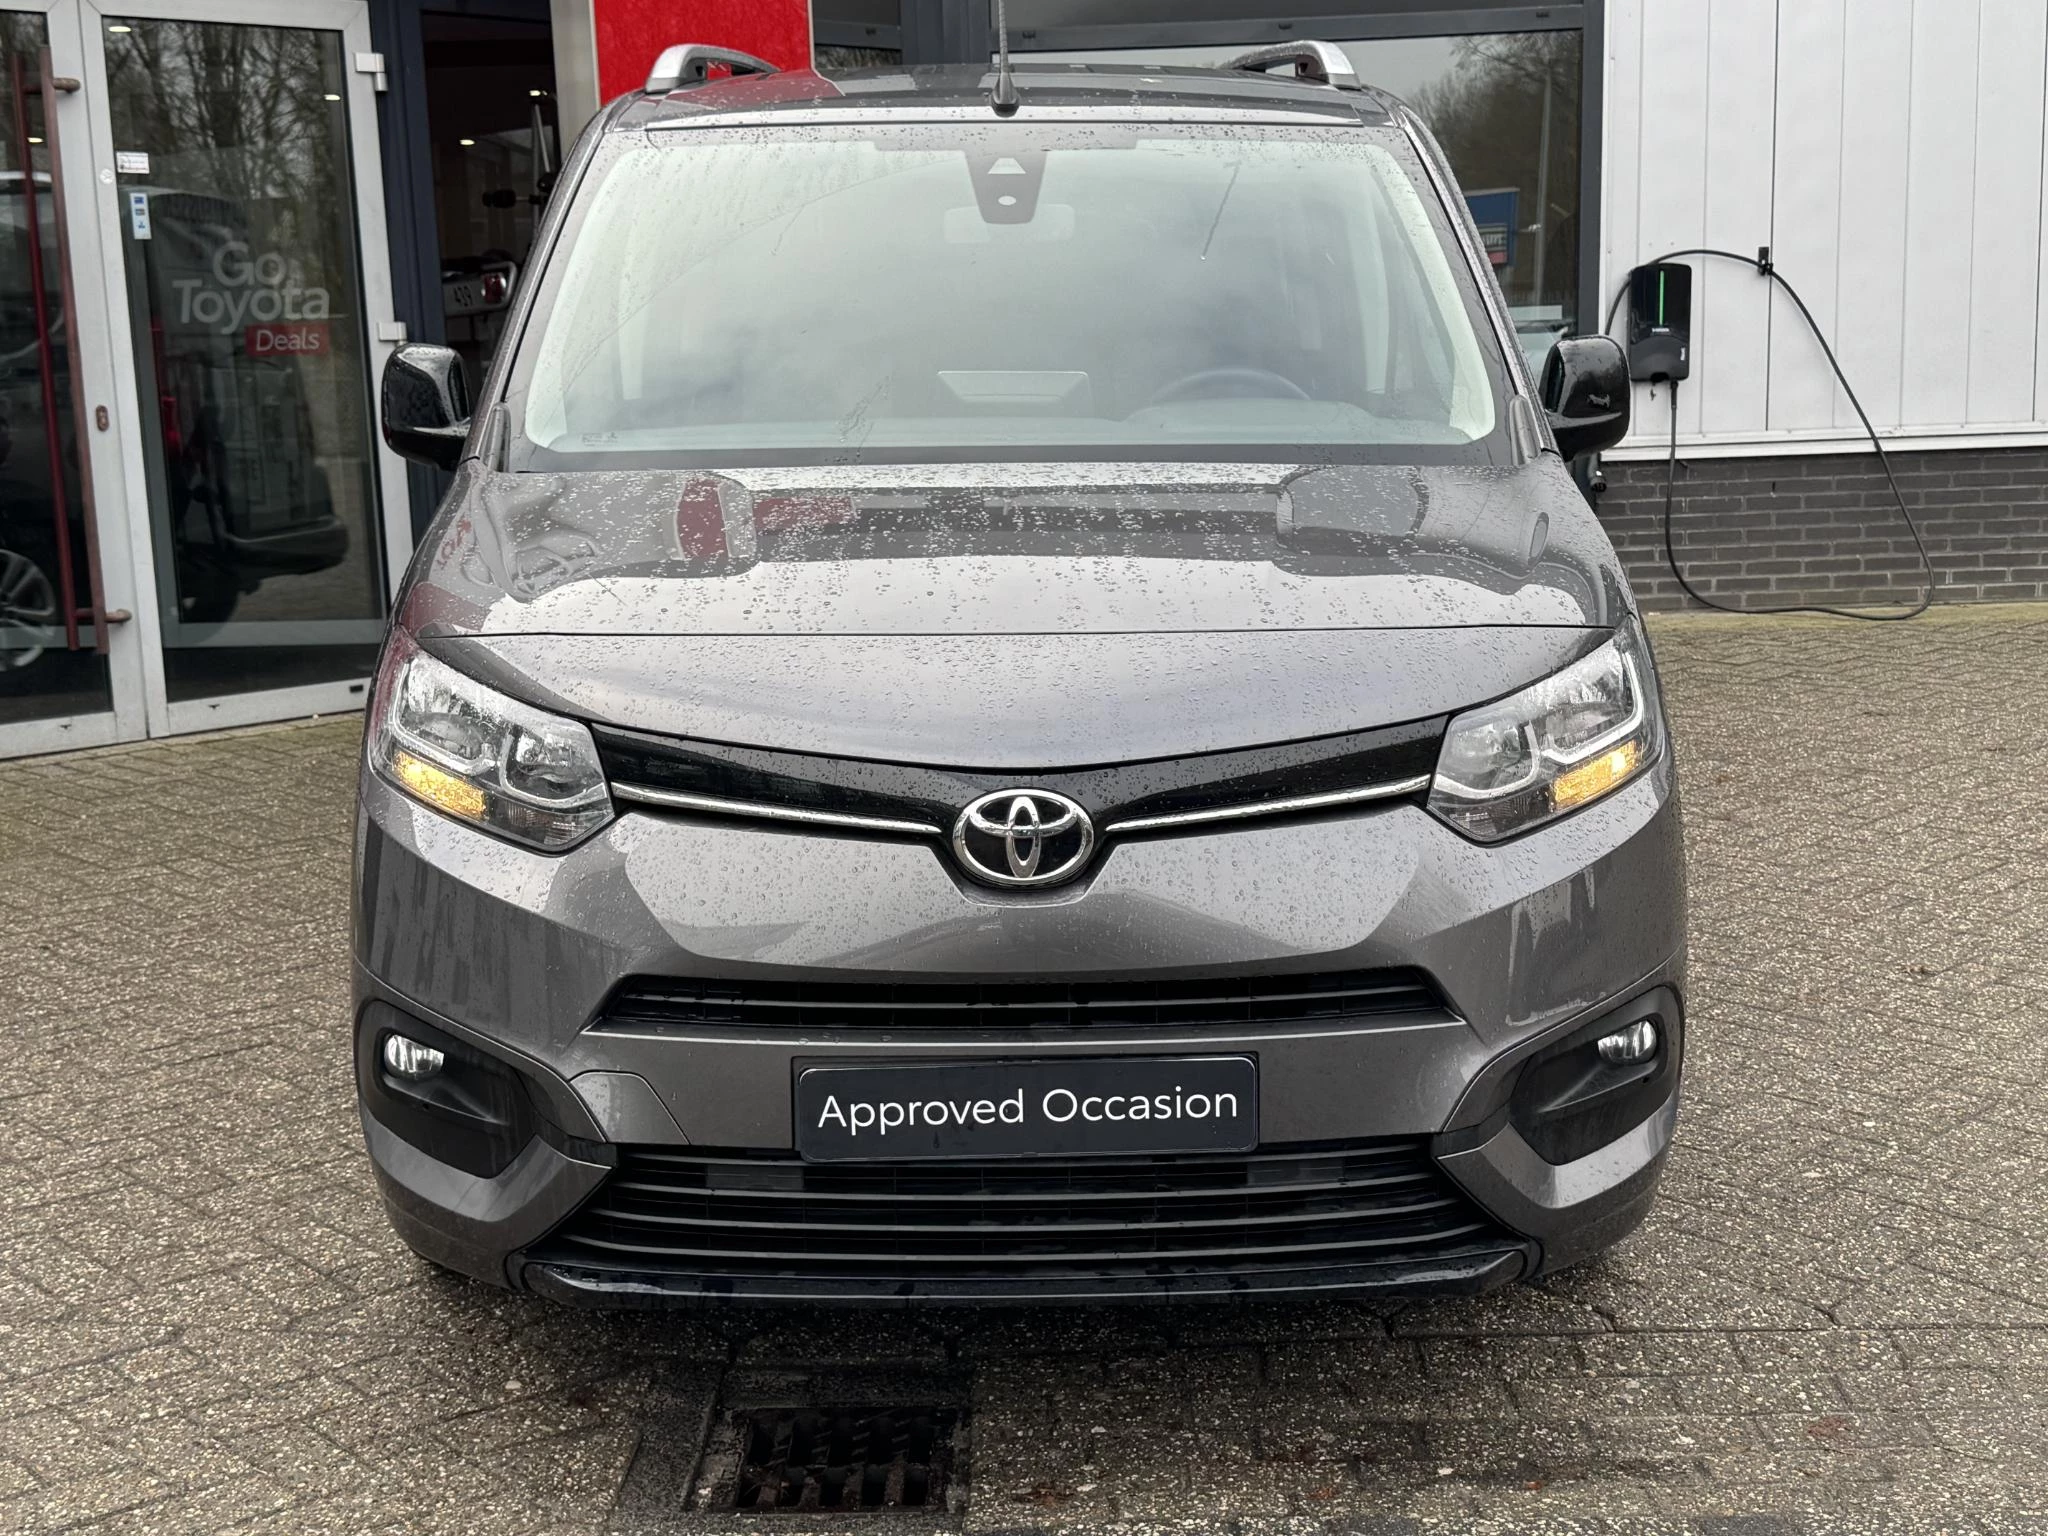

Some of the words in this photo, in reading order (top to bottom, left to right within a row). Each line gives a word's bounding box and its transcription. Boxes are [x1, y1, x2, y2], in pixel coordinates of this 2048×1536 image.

[213, 240, 287, 287] Go
[172, 278, 330, 336] Toyota
[255, 327, 321, 352] Deals
[817, 1088, 1025, 1135] Approved
[1042, 1085, 1238, 1122] Occasion
